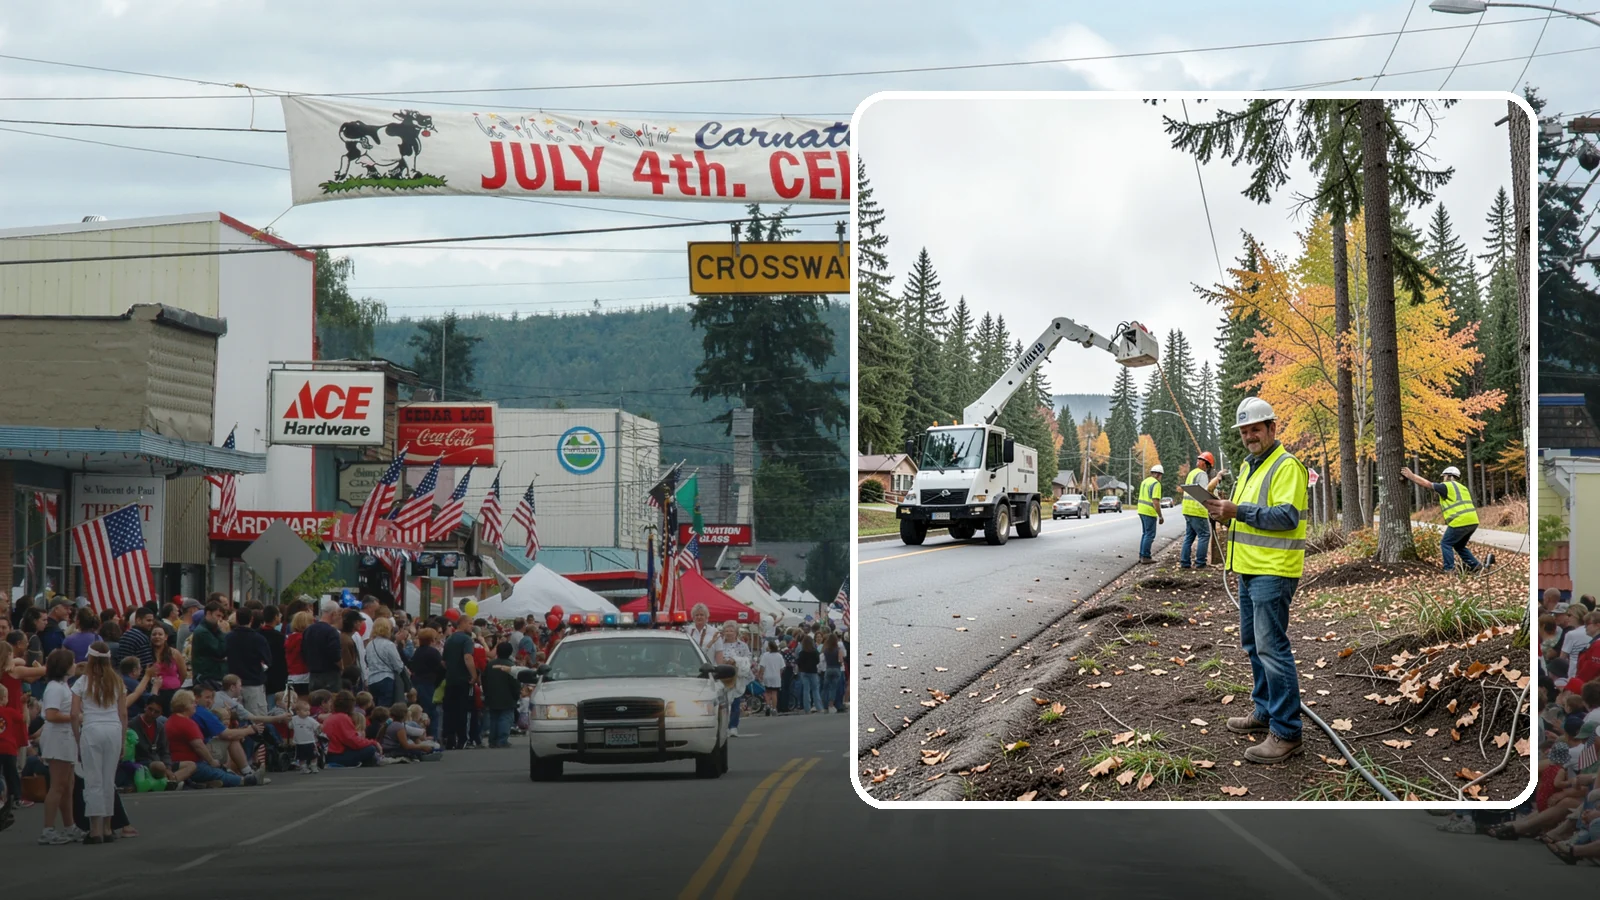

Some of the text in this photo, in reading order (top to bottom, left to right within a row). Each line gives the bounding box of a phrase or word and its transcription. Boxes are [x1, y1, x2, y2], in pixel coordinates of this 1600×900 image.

[695, 121, 850, 150] Carnat
[481, 141, 605, 192] JULY
[632, 149, 746, 198] 4th.
[696, 254, 850, 280] CROSSWA
[283, 380, 373, 420] ACE
[406, 409, 453, 422] CEDAR
[283, 421, 370, 437] Hardware
[416, 428, 476, 447] Coca-Cola
[353, 467, 386, 481] Simpl
[95, 485, 124, 494] Vincent
[126, 486, 136, 495] de
[137, 486, 155, 495] Paul
[688, 526, 741, 535] CRNATION
[699, 535, 730, 543] GLASS
